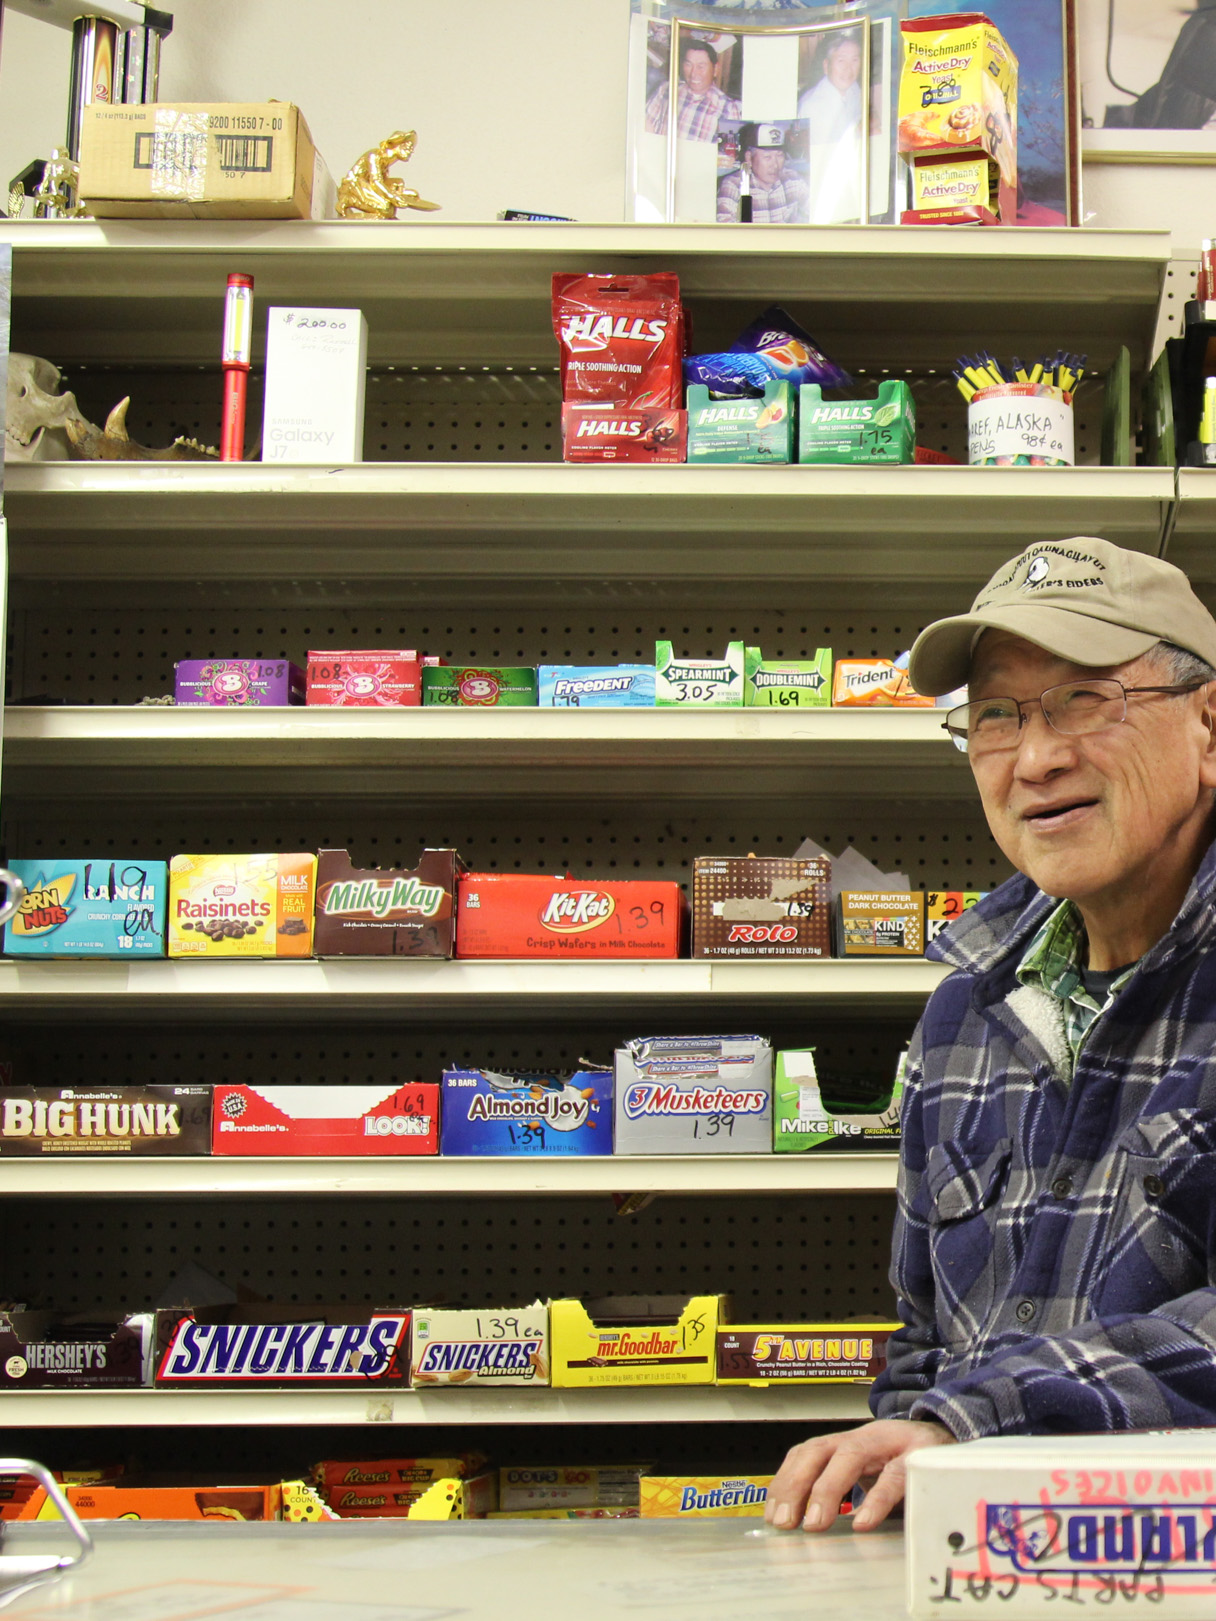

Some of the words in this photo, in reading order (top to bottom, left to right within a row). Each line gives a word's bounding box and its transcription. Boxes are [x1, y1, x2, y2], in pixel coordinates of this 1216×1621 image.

[908, 39, 978, 57] Fleischmann's
[931, 73, 954, 83] Yeast
[919, 166, 981, 183] Fleischmann's
[283, 313, 295, 325] $
[297, 317, 347, 330] 200.00
[563, 315, 667, 343] HALLS
[586, 362, 618, 373] SOOTHING
[618, 363, 642, 374] ACTION
[271, 418, 313, 426] SAMSUNG
[697, 406, 760, 426] HALLS
[811, 406, 873, 424] HALLS
[996, 413, 1053, 433] ALASKA
[576, 420, 641, 437] HALLS
[717, 424, 738, 432] DEFENSE
[269, 428, 335, 447] Galaxy
[269, 445, 288, 459] J7
[257, 663, 285, 679] 1.08
[667, 666, 732, 684] SPEARMINT
[842, 667, 895, 689] Trident
[756, 672, 820, 689] DOUBLEMINT
[675, 683, 717, 702] 3.05
[768, 690, 800, 707] 1.69
[280, 874, 308, 885] MILK
[282, 898, 306, 906] REAL
[466, 901, 481, 909] BARS
[467, 893, 480, 902] 36
[848, 893, 879, 902] PEANUT
[880, 894, 911, 902] BUTTER
[872, 902, 919, 910] CHOCOLATE
[176, 897, 271, 918] Raisinets
[282, 905, 306, 913] FRUIT
[23, 905, 68, 930] NUTS
[874, 920, 905, 932] KIND
[117, 935, 134, 949] 18
[728, 924, 798, 943] Rolo
[526, 937, 556, 950] Crisp
[557, 936, 597, 949] Wafers
[608, 940, 626, 949] Milk
[627, 940, 666, 949] Chocolate
[448, 1079, 457, 1087] 36
[458, 1078, 477, 1087] BARS
[393, 1094, 424, 1112] 1.69
[2, 1099, 75, 1137] BIG
[79, 1102, 181, 1136] HUNK
[219, 1120, 287, 1133] Annabelle's
[364, 1116, 431, 1136] LOOK!
[692, 1114, 736, 1141] 1.39
[780, 1118, 828, 1134] Mike
[833, 1119, 862, 1136] Ike
[508, 1124, 546, 1149] 1.39
[169, 1320, 400, 1375] SNICKERS
[26, 1344, 107, 1369] HERSHEY'S
[424, 1342, 537, 1371] SNICKERS
[850, 1361, 869, 1369] Coating
[478, 1364, 535, 1379] Almond
[343, 1467, 391, 1483] Reese's
[295, 1485, 309, 1496] 16
[340, 1491, 386, 1506] Reese's
[680, 1486, 768, 1512] Butterfin
[75, 1500, 96, 1508] 44000
[290, 1496, 317, 1504] COUNT
